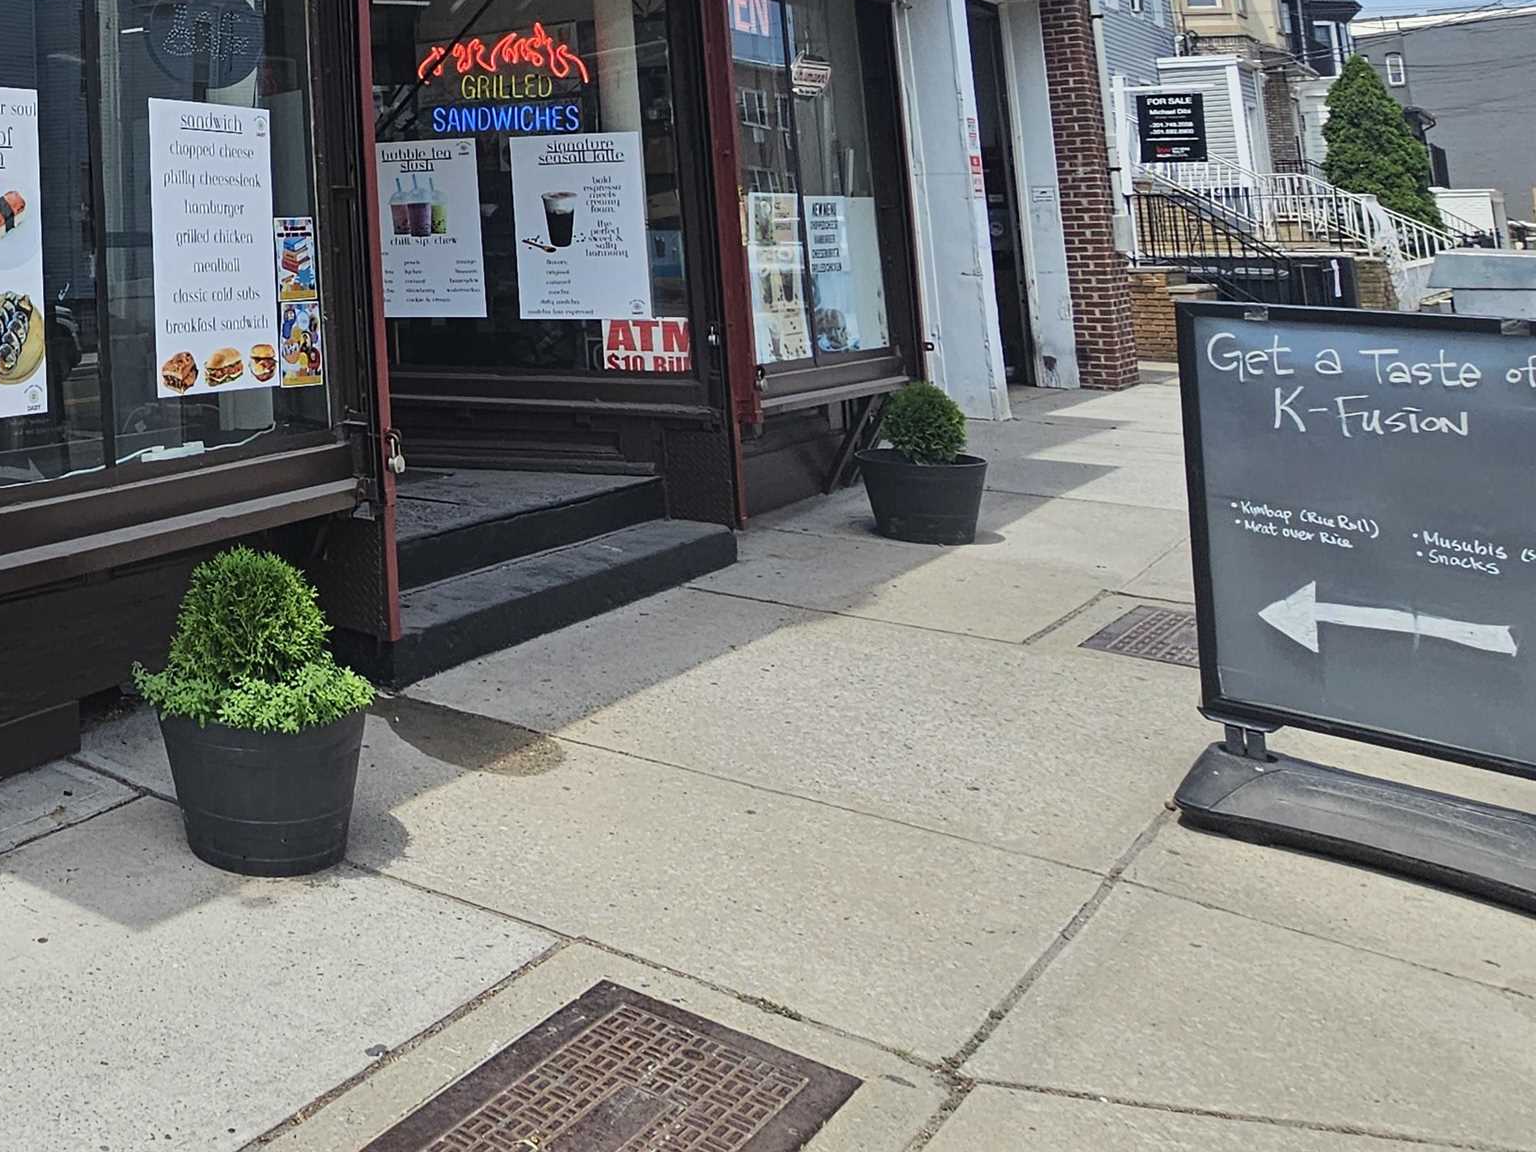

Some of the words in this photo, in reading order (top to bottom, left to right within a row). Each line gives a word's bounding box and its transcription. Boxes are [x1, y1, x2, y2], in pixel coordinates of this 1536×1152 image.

[461, 74, 553, 99] GRILLED
[11, 102, 37, 117] soul
[1146, 98, 1166, 106] FOR
[1168, 97, 1193, 105] SALE
[180, 112, 242, 131] sandwich
[432, 104, 580, 133] SANDWICHES
[169, 140, 215, 159] chopped
[219, 143, 254, 159] cheese
[547, 138, 614, 153] signature
[400, 159, 434, 172] slush
[163, 169, 195, 188] philly
[200, 171, 261, 188] cheesesteak
[184, 199, 245, 218] hamburger
[176, 229, 210, 247] grilled
[213, 229, 253, 244] chicken
[194, 257, 240, 272] meatball
[173, 288, 207, 303] classic
[211, 286, 233, 302] cold
[237, 286, 261, 301] subs
[165, 316, 216, 334] breakfast
[221, 314, 269, 330] sandwich
[1207, 332, 1294, 382] Get
[1314, 349, 1344, 375] a
[1359, 349, 1482, 388] Taste
[1244, 520, 1279, 536] Meat
[1282, 528, 1315, 541] over
[1319, 532, 1354, 549] Rice
[1423, 530, 1508, 560] Musubis
[1428, 549, 1500, 575] Snacks
